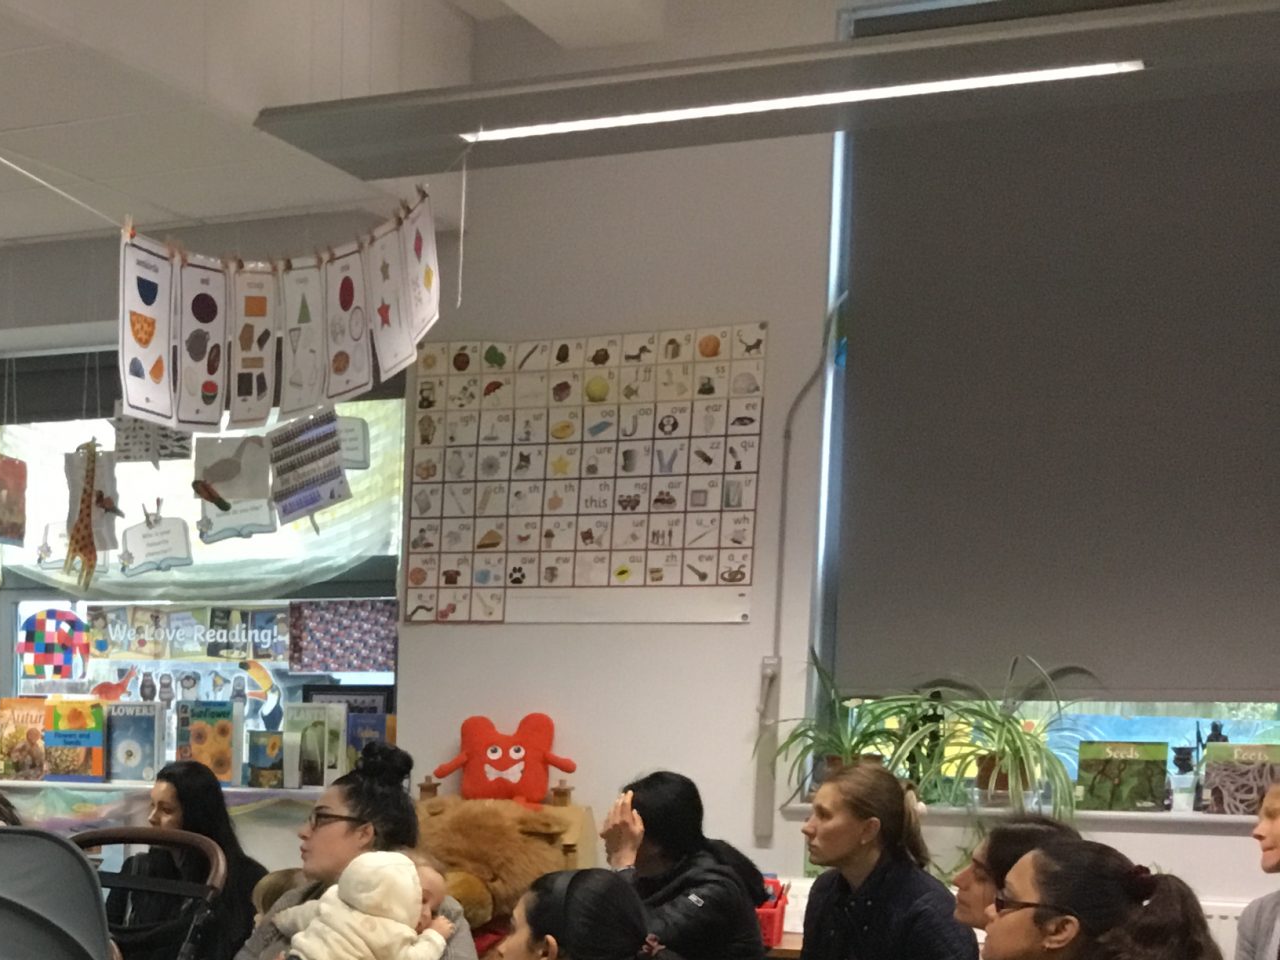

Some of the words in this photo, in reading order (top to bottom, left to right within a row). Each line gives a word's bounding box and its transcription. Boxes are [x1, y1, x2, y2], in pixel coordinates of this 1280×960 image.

[600, 410, 615, 418] oo
[671, 406, 688, 414] ow
[705, 404, 723, 412] ear
[745, 402, 758, 410] ee
[740, 440, 755, 452] qu
[634, 482, 648, 493] ng
[668, 479, 682, 489] air
[585, 496, 608, 509] this
[733, 515, 750, 525] wh
[698, 554, 714, 562] ew
[109, 623, 136, 641] We
[145, 624, 186, 641] Love
[195, 624, 278, 649] Reading!
[1104, 747, 1140, 759] Seeds
